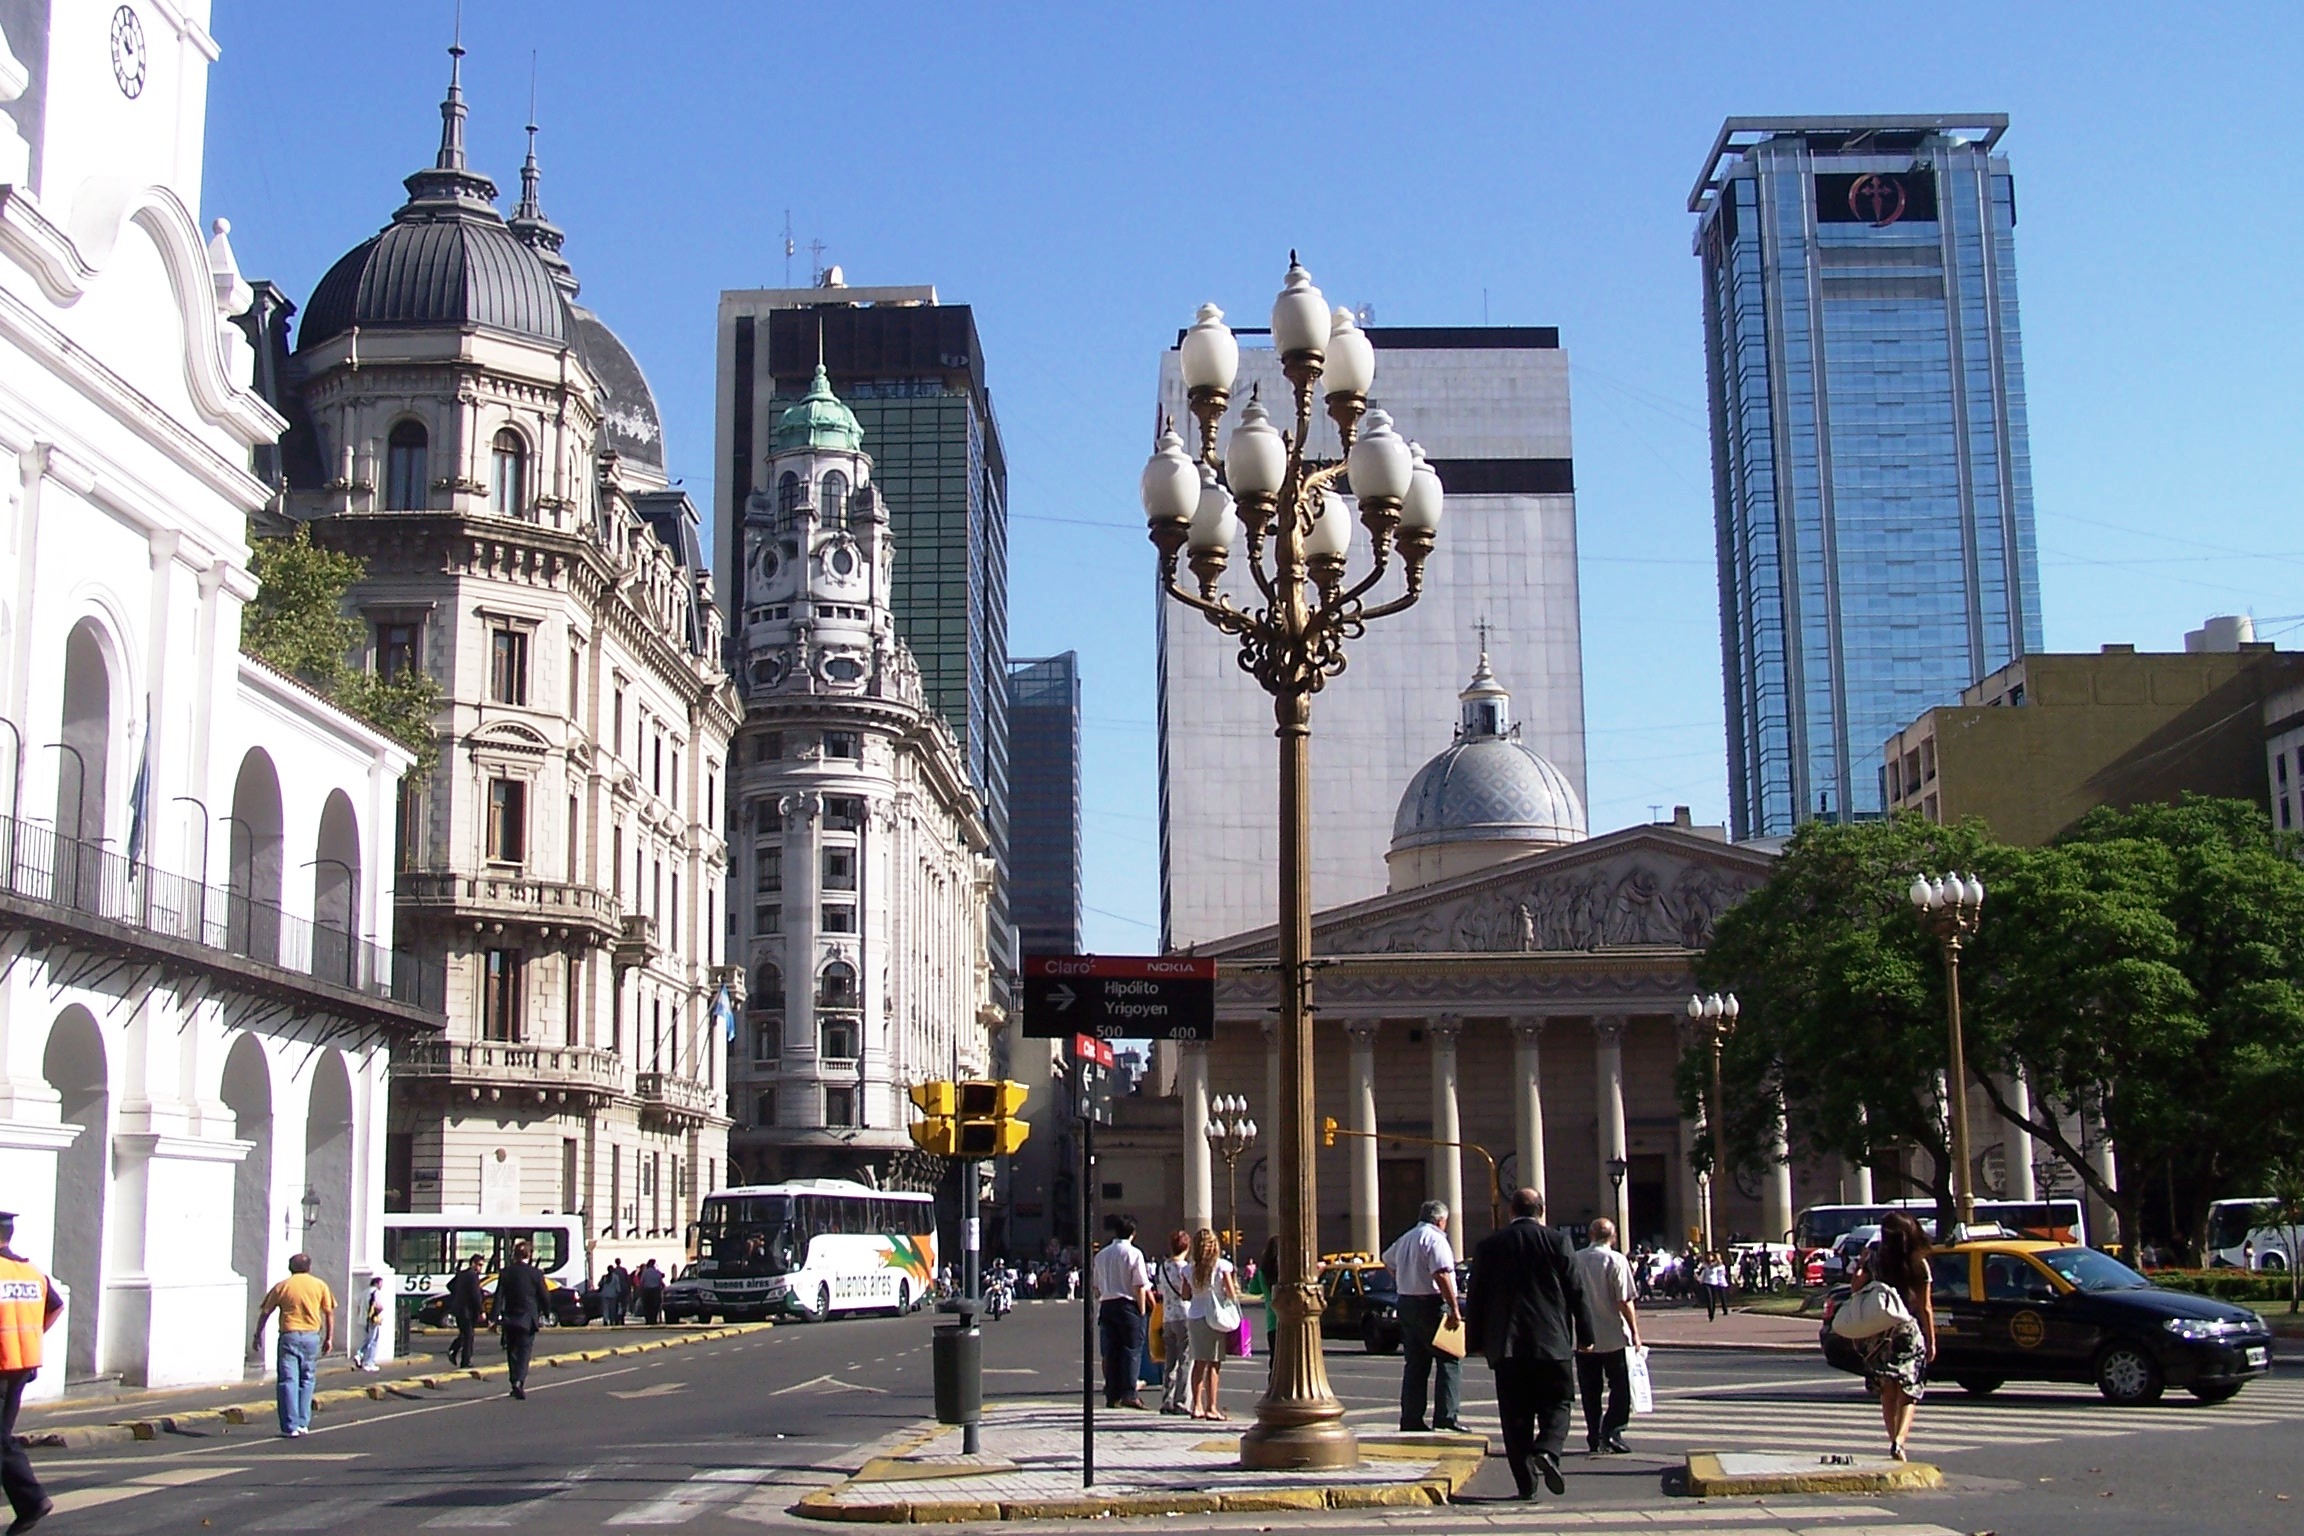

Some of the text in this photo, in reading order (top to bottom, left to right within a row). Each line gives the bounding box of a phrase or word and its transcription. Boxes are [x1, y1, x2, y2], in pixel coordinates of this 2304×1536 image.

[1045, 959, 1195, 974] Claro NOKIA
[1104, 980, 1159, 997] Hipólito
[1104, 1001, 1168, 1018] Yrigoyen
[1096, 1025, 1196, 1039] 500 400
[404, 1275, 432, 1292] 56
[836, 1270, 891, 1298] buenos aires
